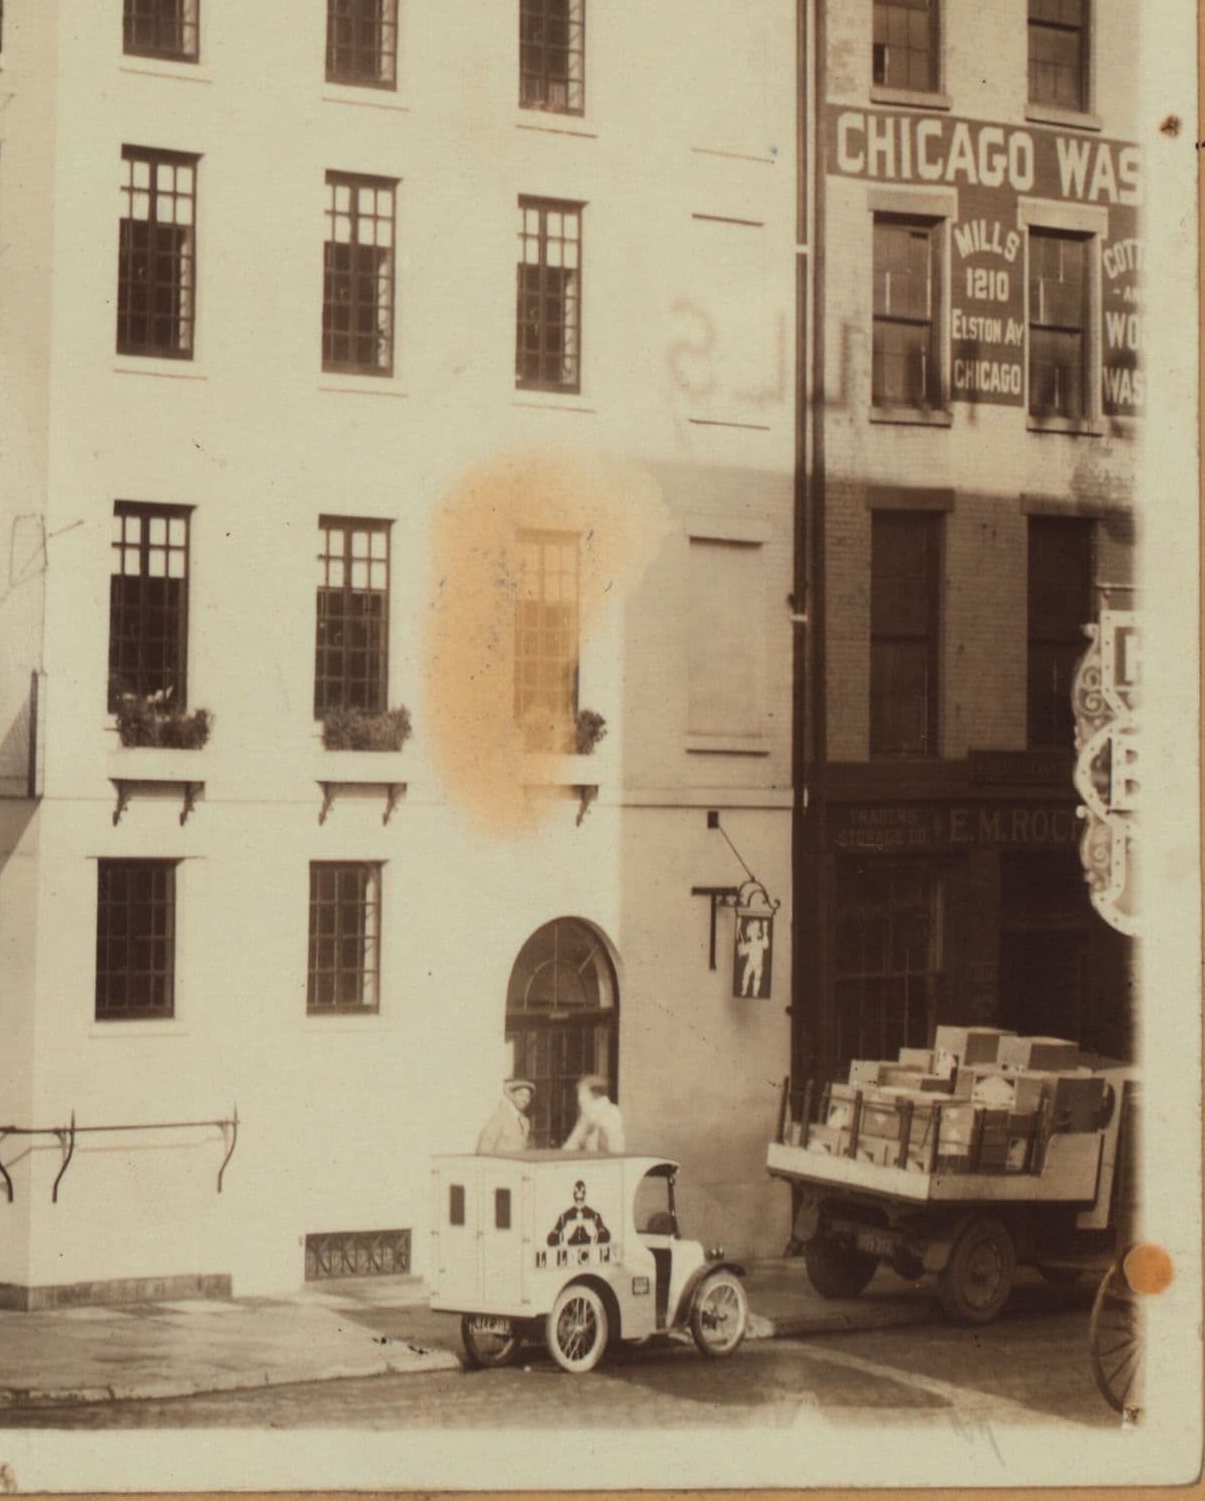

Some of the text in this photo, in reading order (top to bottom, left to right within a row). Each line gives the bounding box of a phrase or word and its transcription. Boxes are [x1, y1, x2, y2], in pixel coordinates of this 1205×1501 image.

[837, 112, 1034, 191] CHICAGO
[955, 220, 1020, 262] MILLS
[967, 268, 1009, 301] 1210
[953, 308, 1001, 343] ELSTON
[954, 358, 1021, 395] CHICAGO
